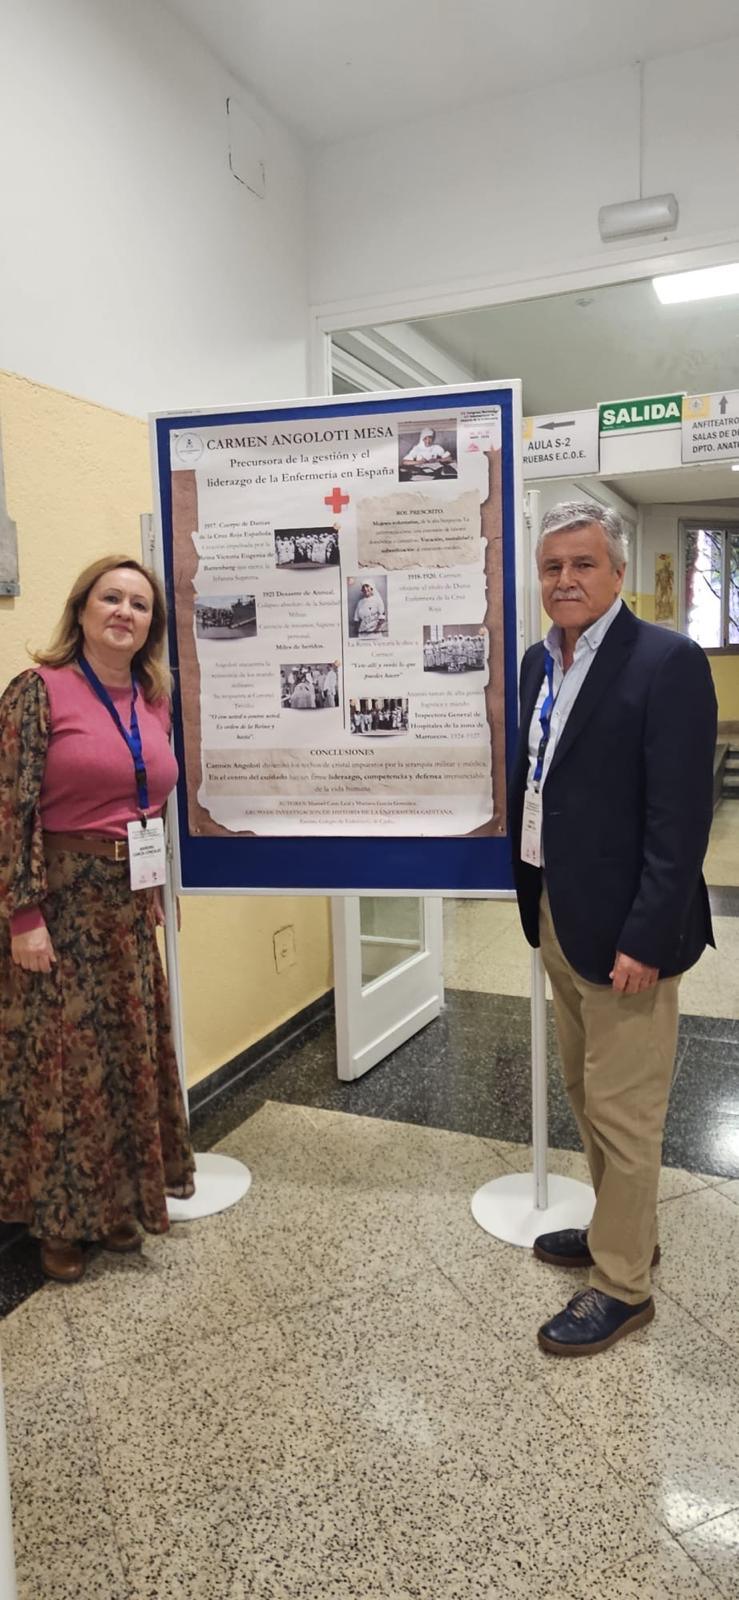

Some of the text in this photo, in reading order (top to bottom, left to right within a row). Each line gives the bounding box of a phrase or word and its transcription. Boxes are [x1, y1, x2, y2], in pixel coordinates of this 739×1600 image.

[602, 402, 680, 425] SALIDA
[692, 417, 739, 428] ANFITEATRO
[207, 427, 393, 450] CARMEN ANGOLOTI MESA
[692, 429, 739, 441] SALAS DE D
[528, 437, 571, 450] AULA S-2
[692, 442, 739, 453] DPTO. ANAT
[230, 449, 369, 468] Precursora de la gestión y el
[522, 450, 586, 463] RUEBAS E.C.O.E.
[207, 478, 252, 488] liderazgo
[255, 475, 266, 484] de
[269, 475, 278, 483] la
[356, 467, 394, 479] España
